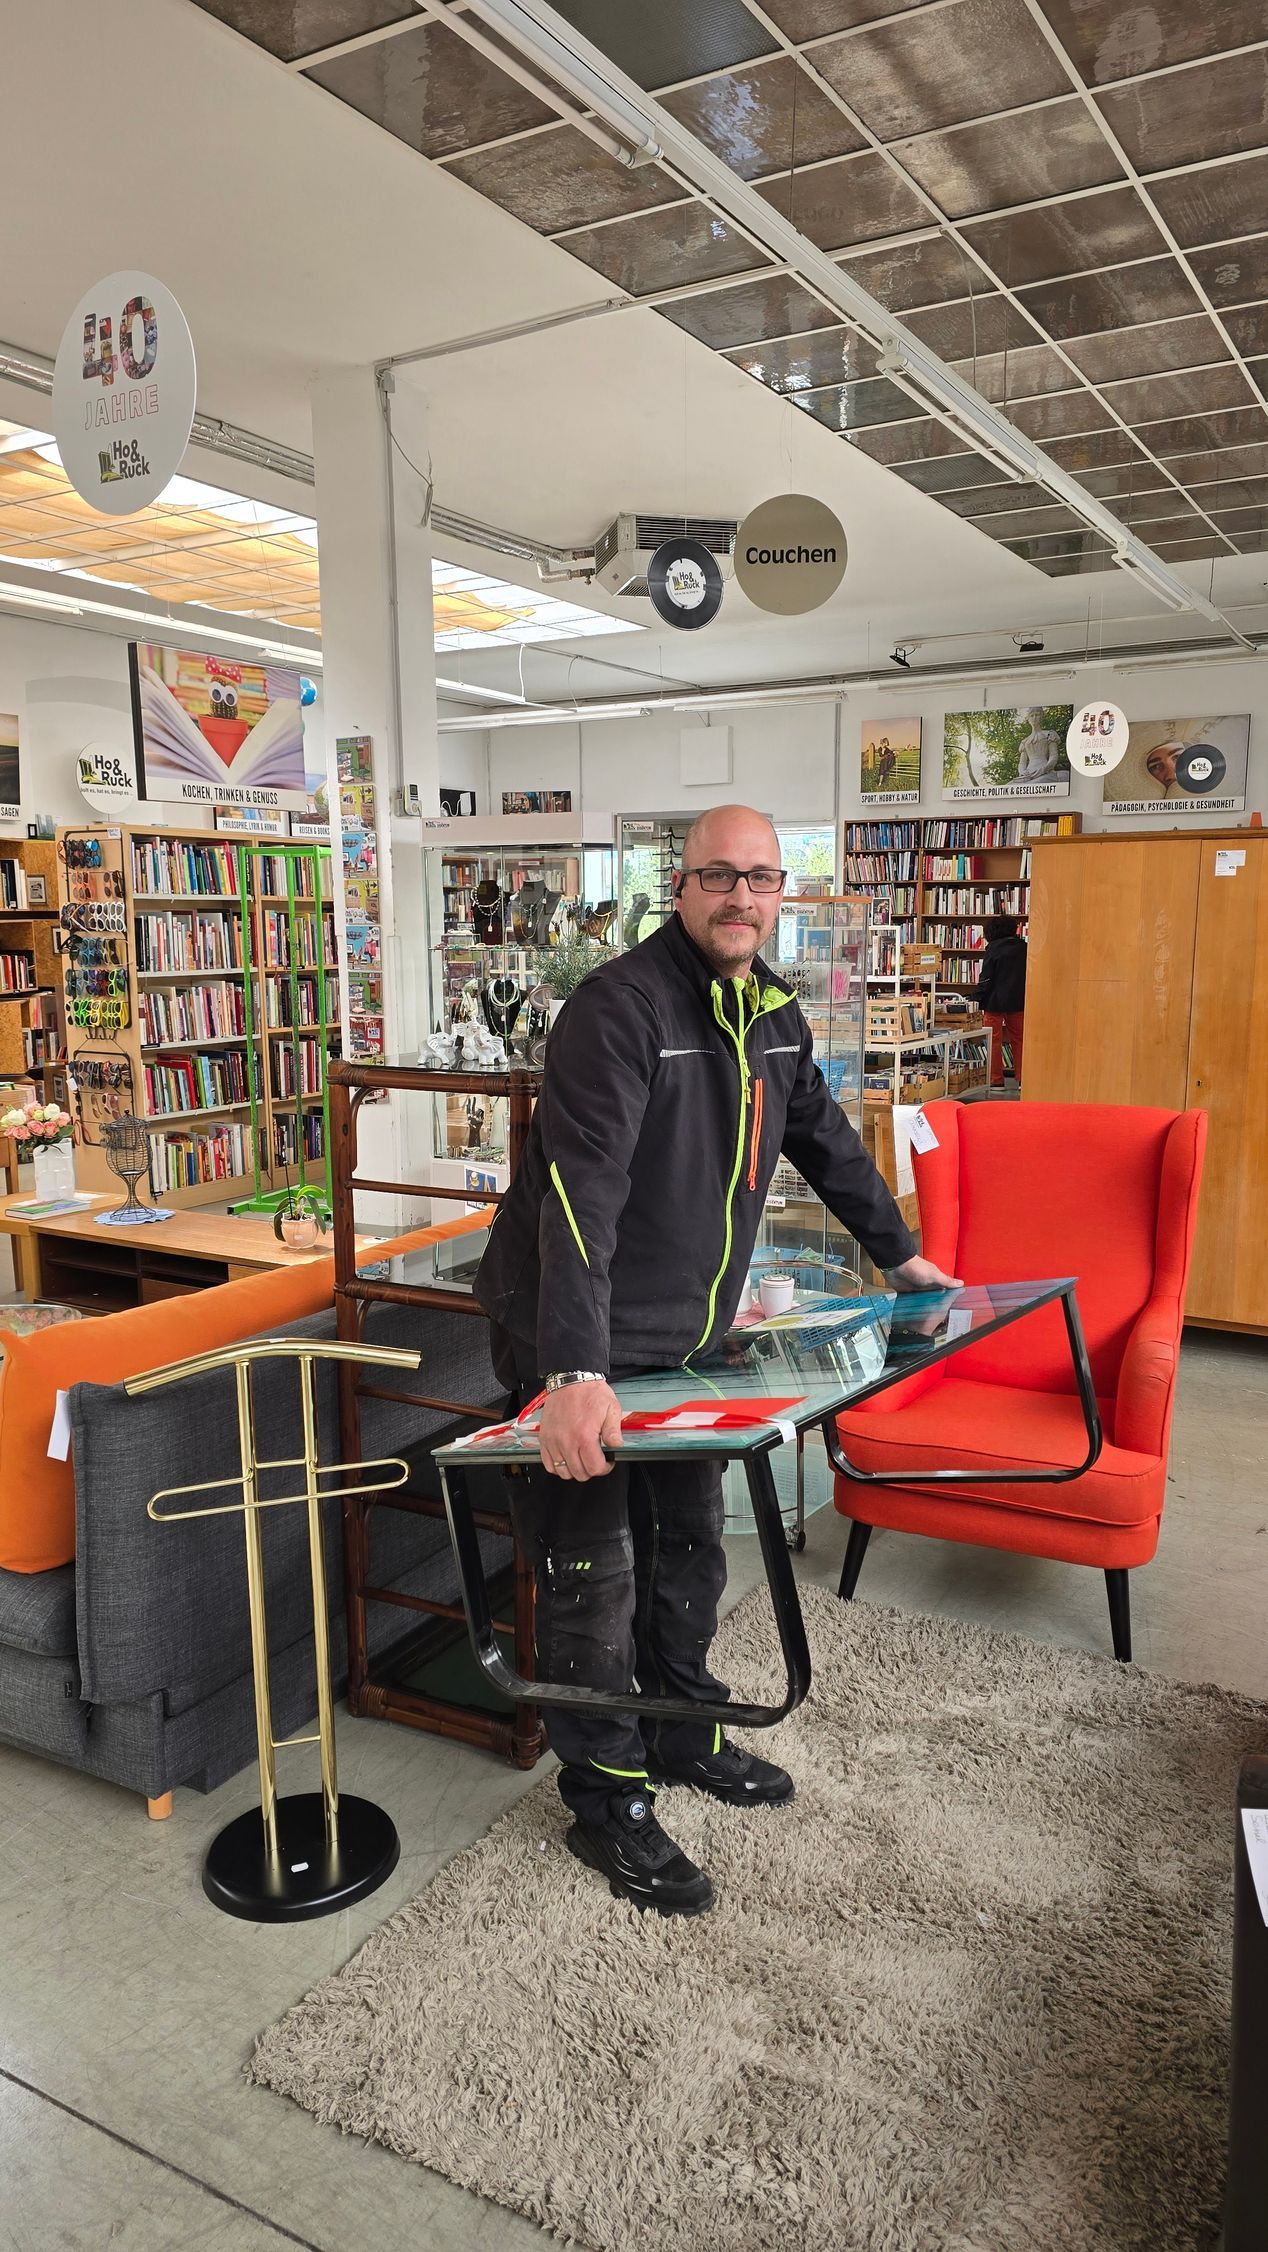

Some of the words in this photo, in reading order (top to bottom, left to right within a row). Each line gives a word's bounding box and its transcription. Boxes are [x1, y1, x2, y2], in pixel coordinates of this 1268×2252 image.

[83, 296, 157, 386] 40
[85, 384, 159, 430] JAHRE
[113, 439, 141, 463] Ho&
[119, 455, 151, 479] Ruck
[746, 546, 836, 564] Couchen
[680, 572, 694, 583] Ho&
[684, 580, 700, 590] Ruck
[1081, 710, 1115, 736] 40
[1080, 737, 1113, 749] JAHRE
[94, 754, 123, 776] Ho&
[101, 771, 133, 788] Ruck
[181, 783, 214, 802] KOCHEN,
[214, 787, 245, 803] TRINKEN
[245, 790, 251, 803] &
[252, 790, 278, 805] GENUSS
[901, 792, 918, 802] NATUR
[953, 788, 987, 798] GESCHICHTE,
[988, 786, 1009, 796] POLITIK
[1010, 787, 1014, 795] &
[1015, 785, 1057, 795] GESELLSCHAFT
[0, 806, 20, 817] SAGEN
[1111, 803, 1147, 813] PÄDAGOGIK,
[1148, 801, 1188, 811] PSYCHOLOGIE
[1189, 800, 1195, 810] &
[1196, 799, 1235, 810] GESUNDHEIT
